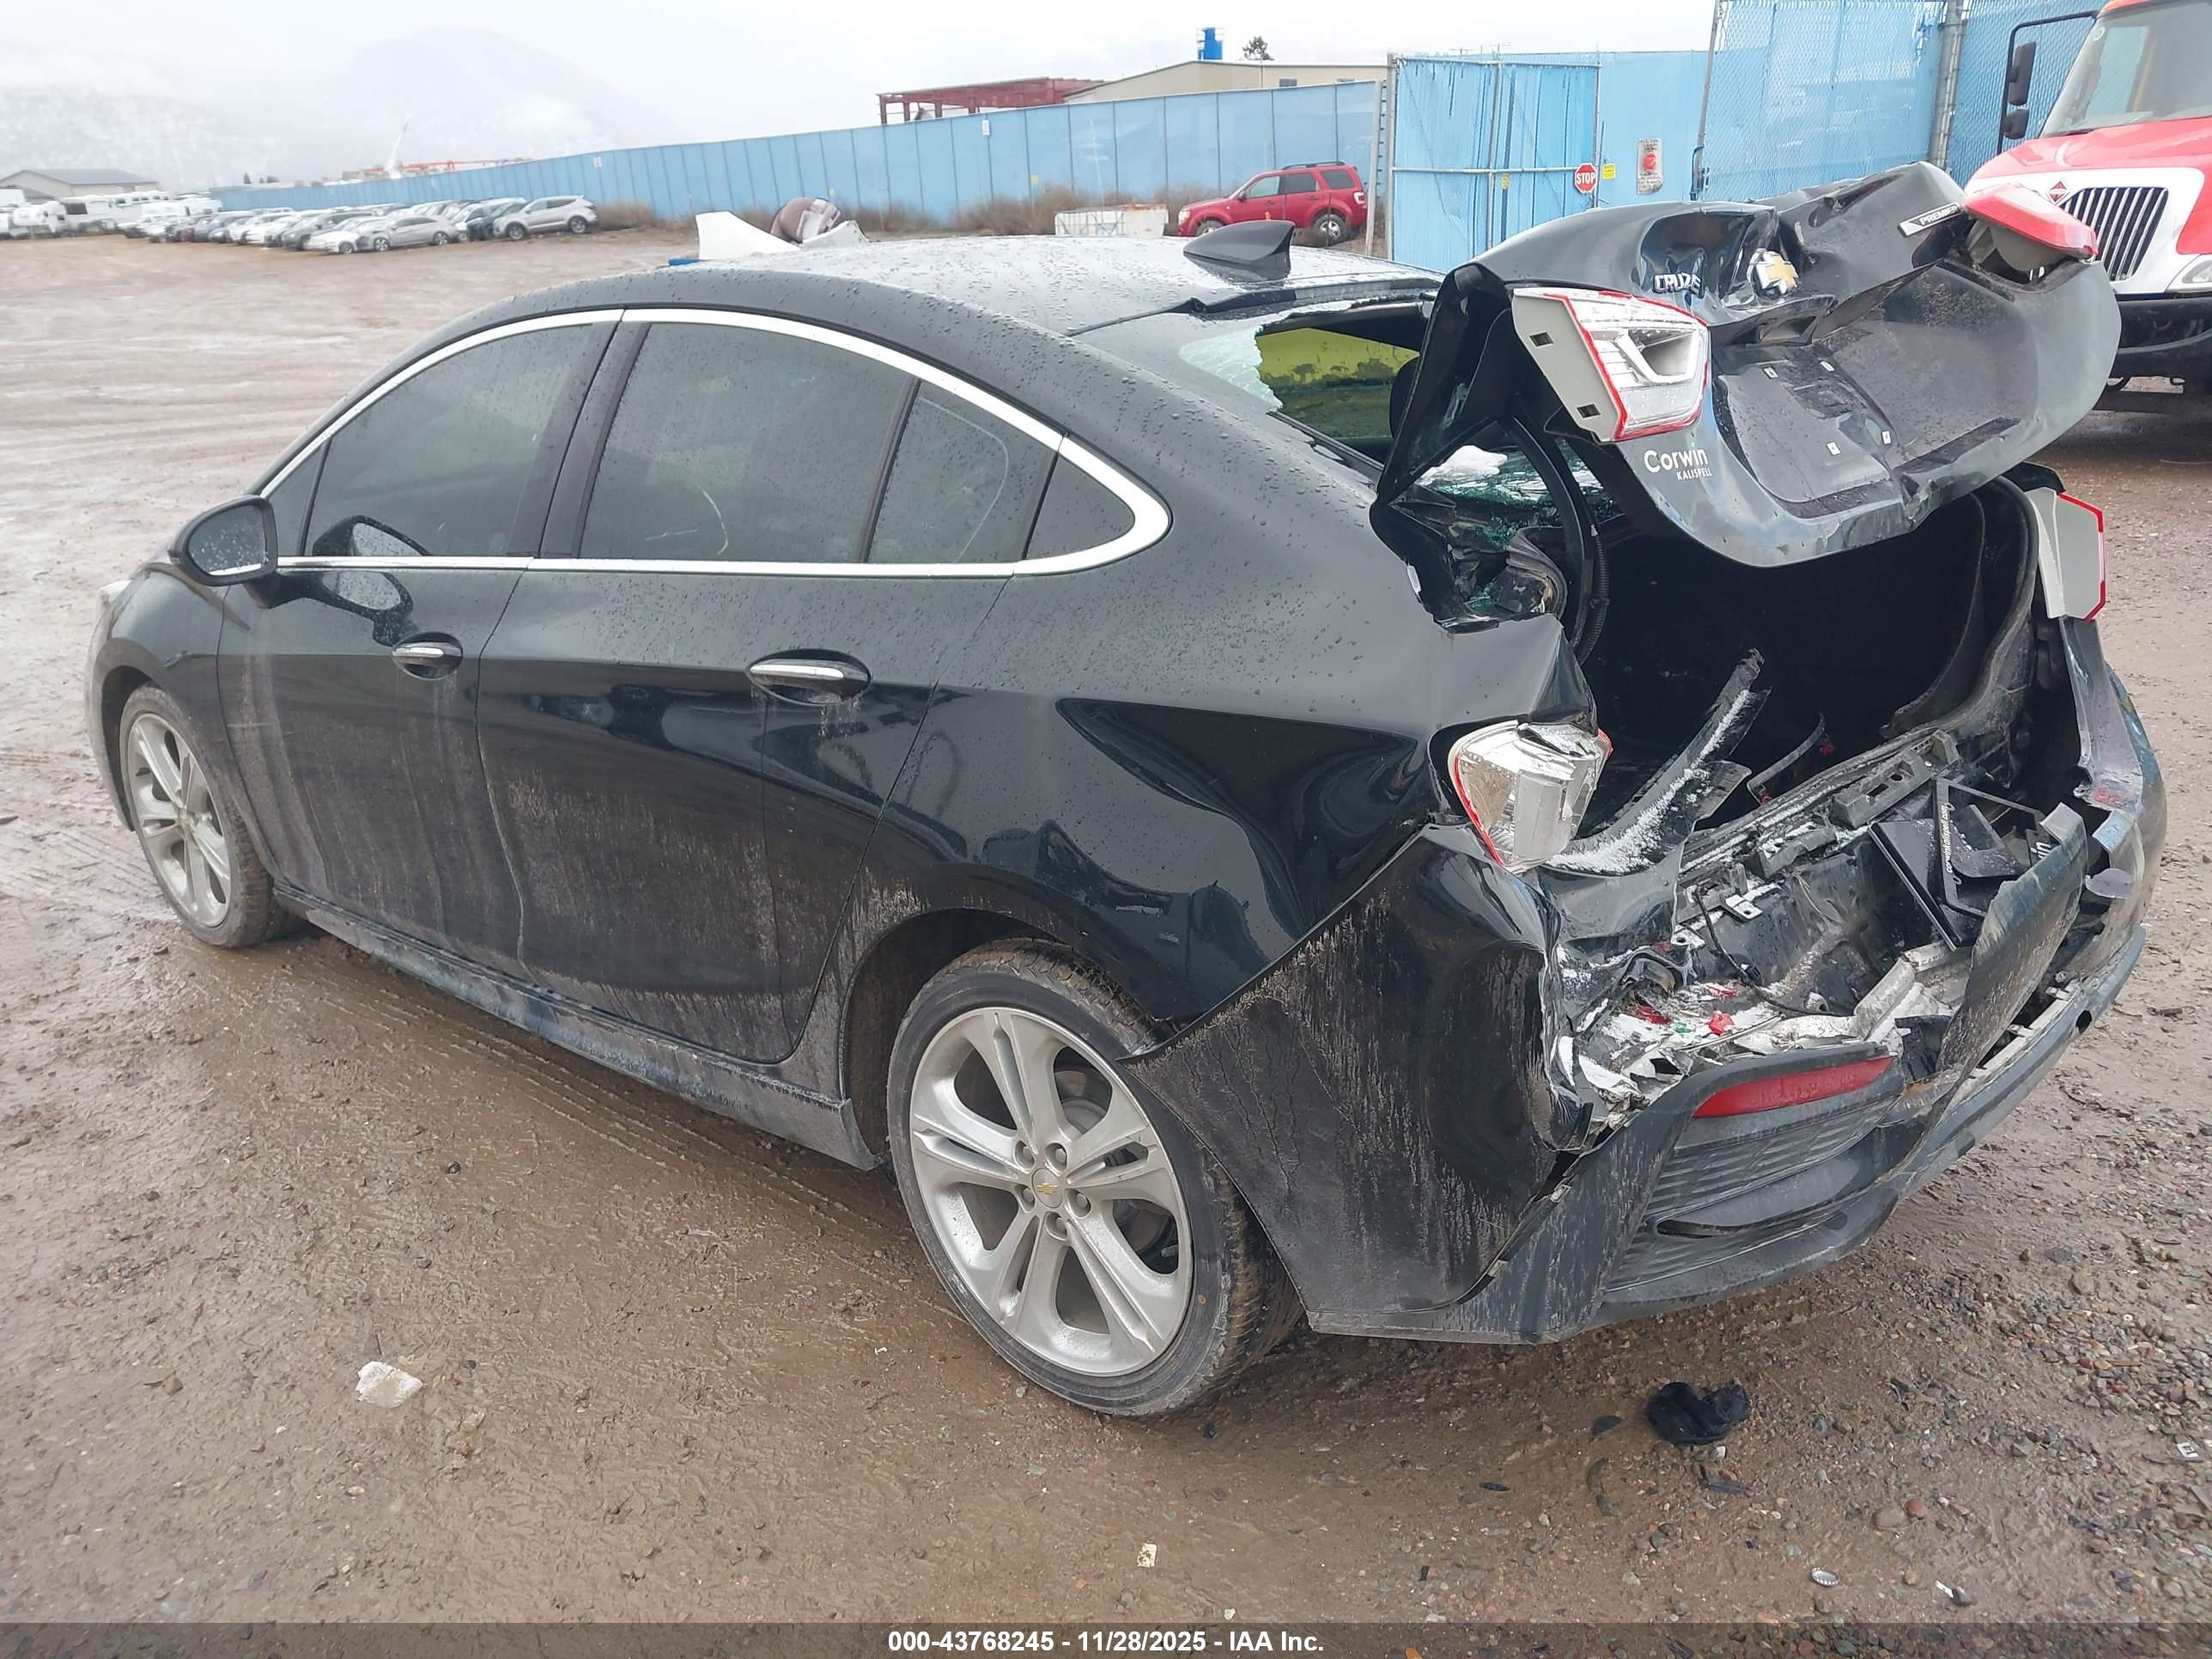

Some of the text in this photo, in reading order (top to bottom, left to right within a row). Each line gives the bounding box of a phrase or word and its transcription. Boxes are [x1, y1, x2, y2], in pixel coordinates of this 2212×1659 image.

[1576, 172, 1595, 185] STOP
[1918, 205, 1959, 226] PREMIER
[1653, 271, 1702, 294] CRUZE
[1644, 441, 1709, 473] Corwin
[1676, 466, 1712, 481] KALISPELL
